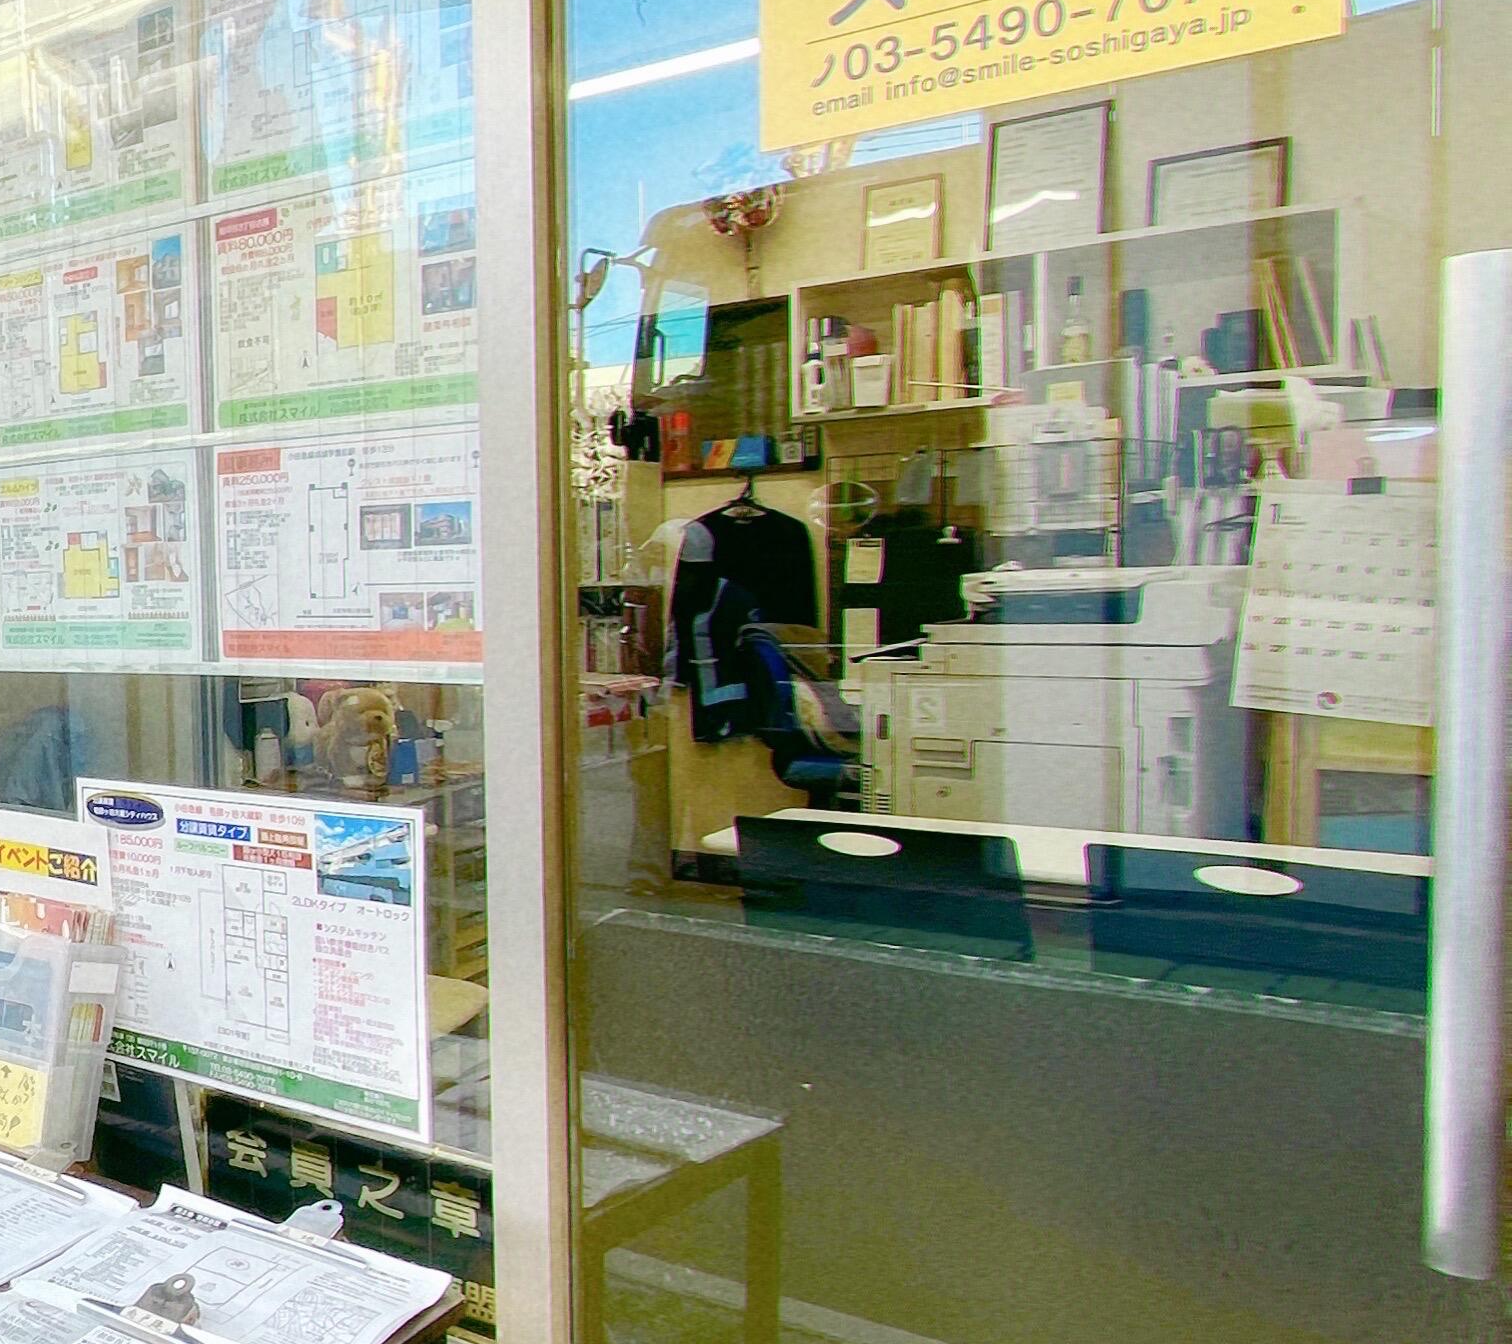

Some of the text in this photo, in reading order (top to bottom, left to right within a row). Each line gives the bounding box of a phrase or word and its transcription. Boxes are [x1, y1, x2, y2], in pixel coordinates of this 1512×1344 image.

[812, 6, 1253, 116] email info@smile-soshigaya.jp
[240, 405, 320, 424] 株式会社スマイル
[179, 820, 249, 840] 分譲賃貸タイプ
[356, 907, 410, 923] オートロック
[226, 1129, 482, 1239] 会員之章
